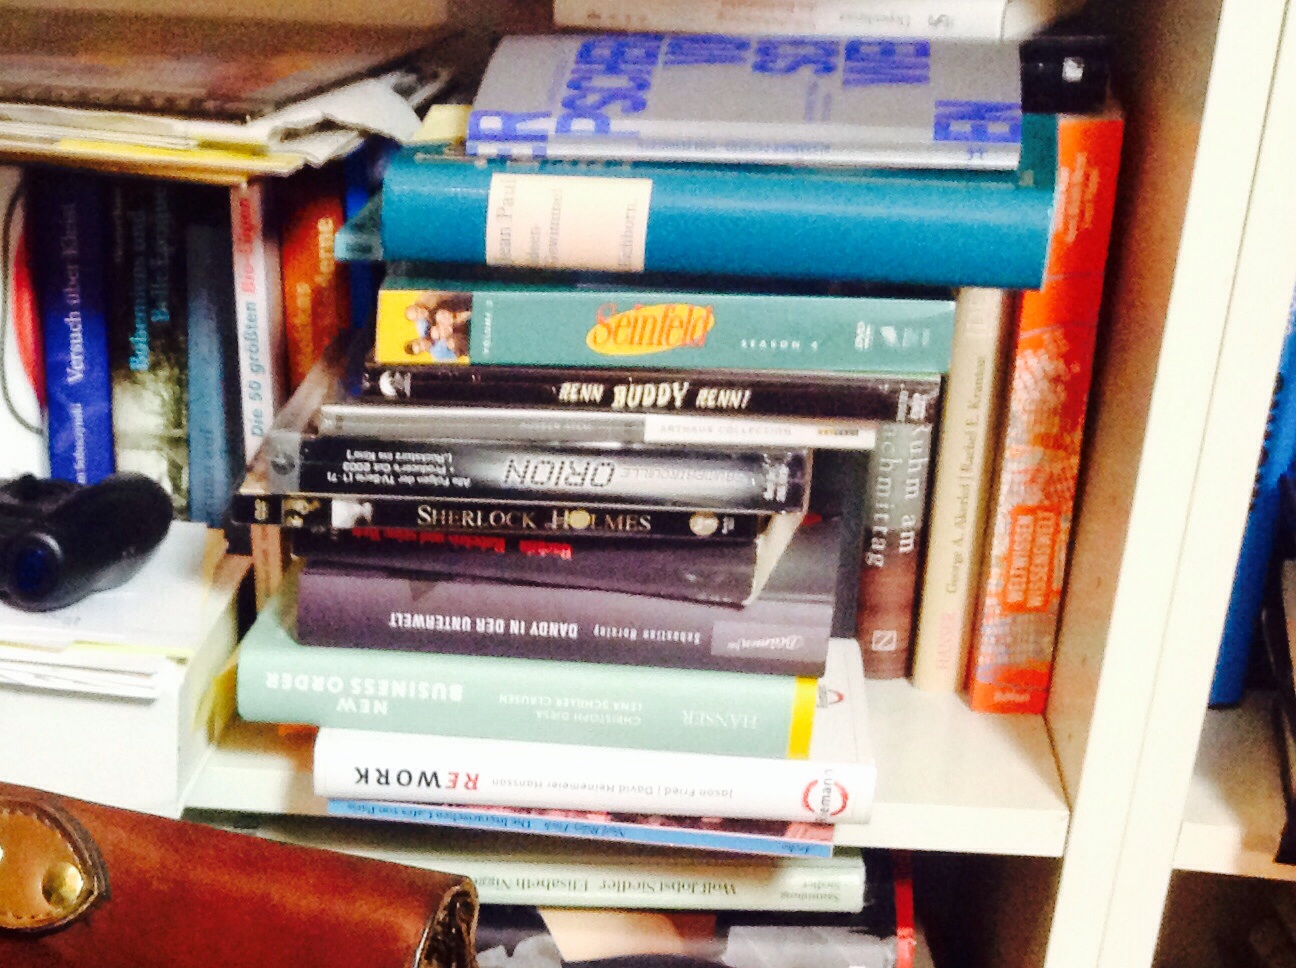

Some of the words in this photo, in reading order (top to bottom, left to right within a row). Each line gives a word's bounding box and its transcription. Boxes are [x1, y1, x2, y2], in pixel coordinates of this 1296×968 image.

[496, 178, 516, 218] Paul
[592, 301, 716, 350] Seinfeld
[741, 340, 804, 351] SEASON
[66, 311, 84, 385] Versuch
[241, 301, 265, 374] größten
[248, 380, 263, 402] 50
[611, 381, 690, 410] BUDDY
[250, 409, 264, 437] Die
[501, 457, 616, 488] ORION
[865, 423, 901, 569] achmittag
[416, 504, 536, 529] SHERLOCK
[551, 510, 652, 533] HOLMES
[897, 514, 921, 554] am
[388, 611, 472, 632] UNTERWELT
[474, 616, 505, 636] DER
[511, 619, 525, 636] IN
[530, 619, 579, 640] DANDY
[263, 673, 346, 694] ORDER
[349, 677, 463, 703] BUSINESS
[336, 697, 388, 717] NEW
[499, 692, 552, 707] CLAUSEN
[682, 709, 759, 730] HANSER
[352, 765, 480, 792] REWORK
[491, 777, 543, 790] Hansson
[546, 778, 616, 794] Heinemeier
[619, 783, 654, 796] David
[663, 786, 694, 798] Fried
[473, 873, 512, 890] Nigge
[515, 876, 589, 893] Elisabeth
[598, 878, 656, 896] Siedler
[658, 879, 700, 896] Jobst
[702, 881, 736, 897] Wolf
